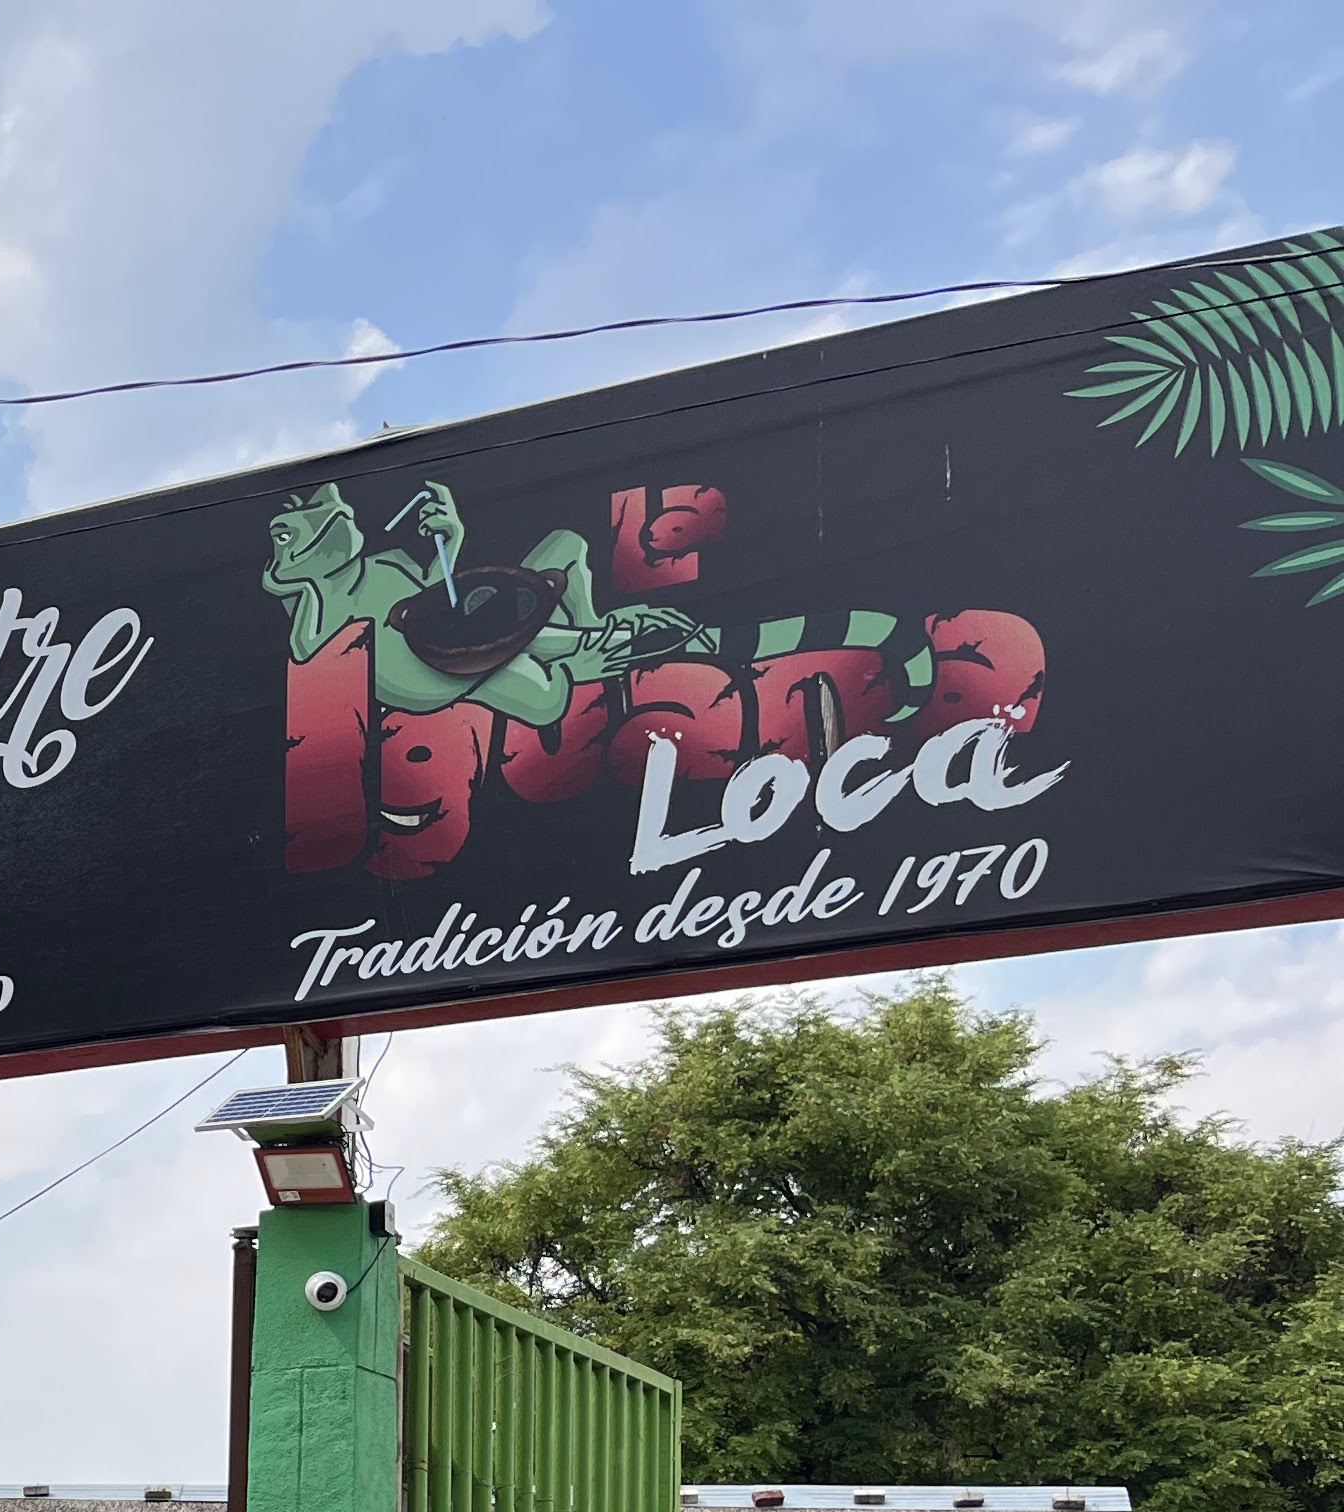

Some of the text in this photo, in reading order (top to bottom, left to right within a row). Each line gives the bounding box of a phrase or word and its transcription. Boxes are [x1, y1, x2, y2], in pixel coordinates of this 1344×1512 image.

[284, 608, 1047, 880] Iguana
[630, 705, 1074, 875] Loca
[289, 838, 1050, 1001] Tradición desde 1970
